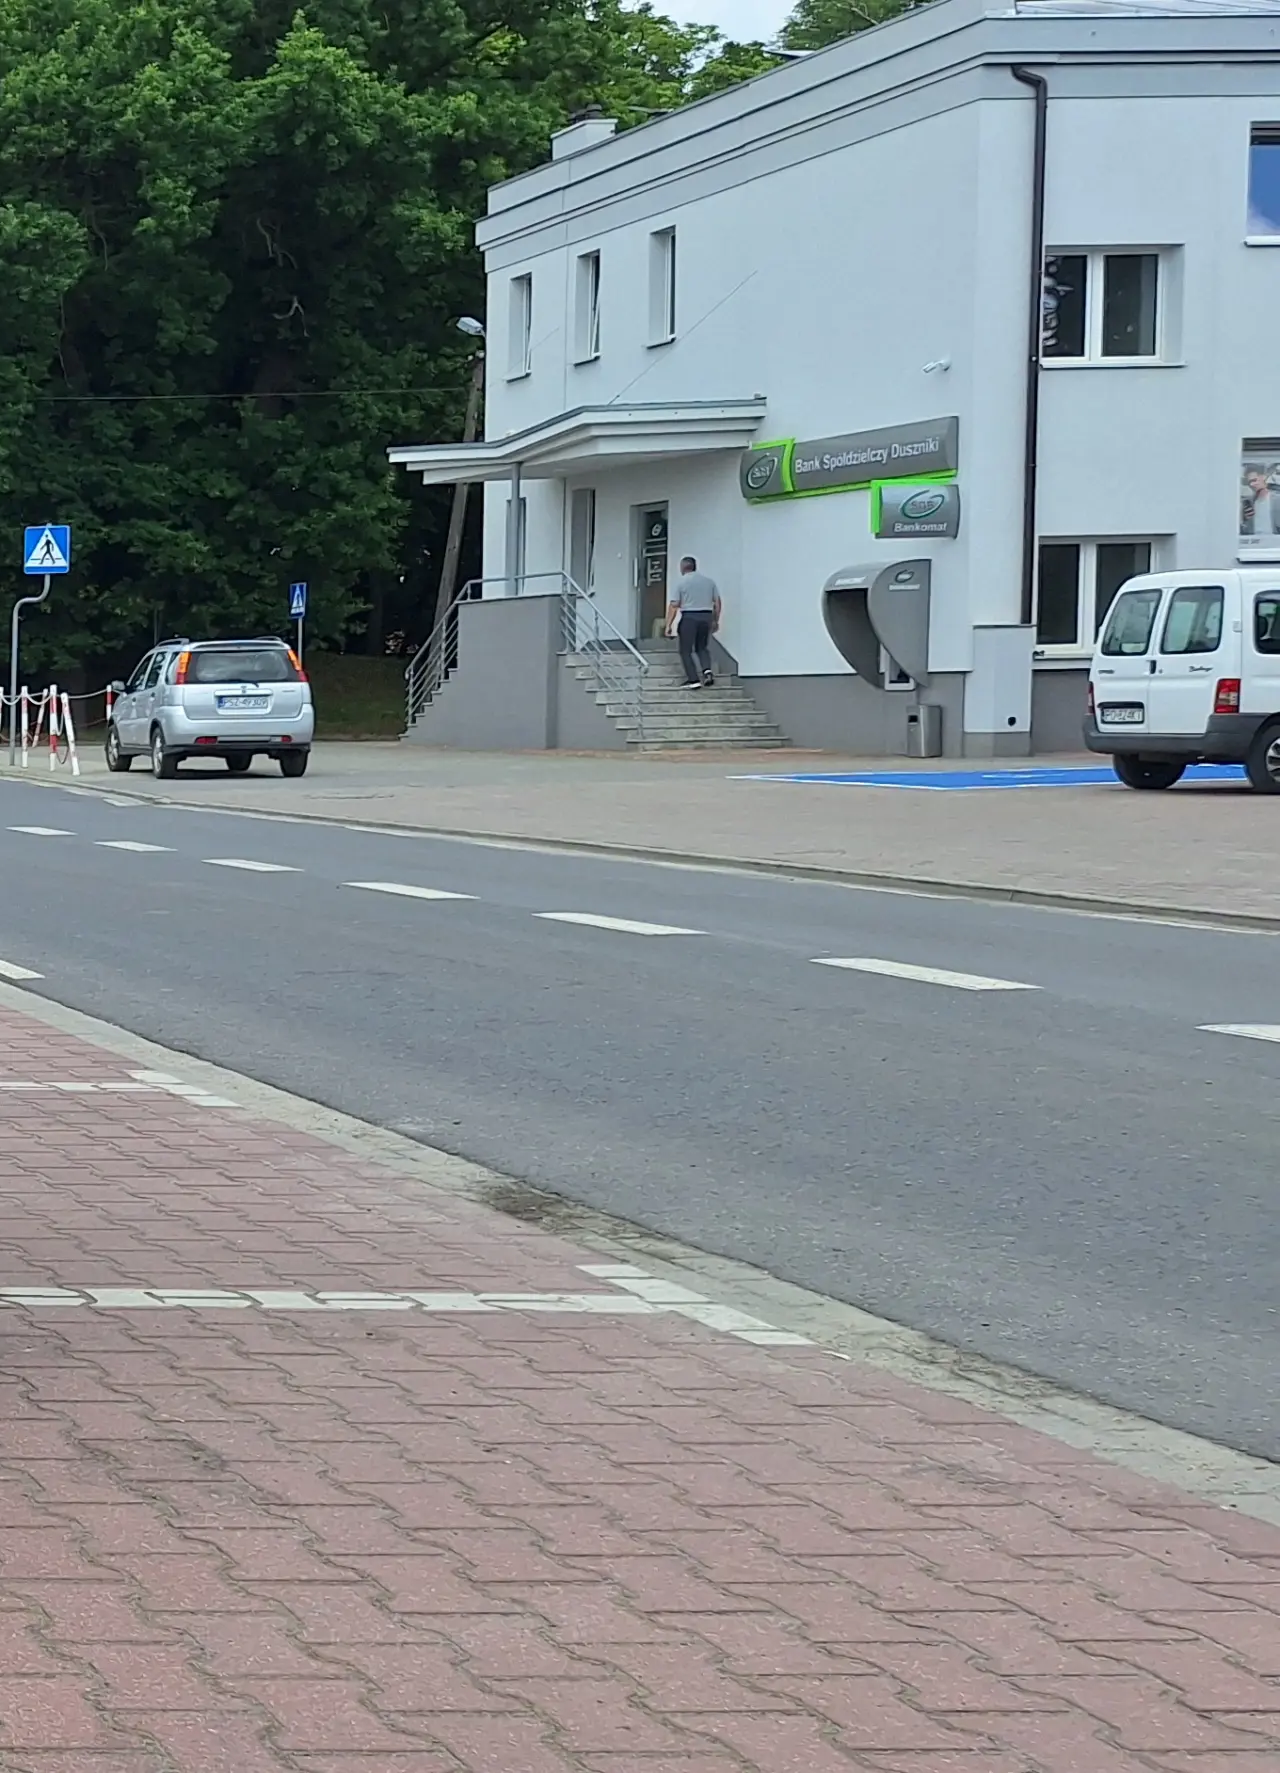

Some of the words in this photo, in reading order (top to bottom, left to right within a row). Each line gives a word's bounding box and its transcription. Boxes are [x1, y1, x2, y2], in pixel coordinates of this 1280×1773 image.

[795, 456, 820, 474] Bank
[891, 437, 940, 458] Duszniki
[893, 522, 948, 532] Bankomat
